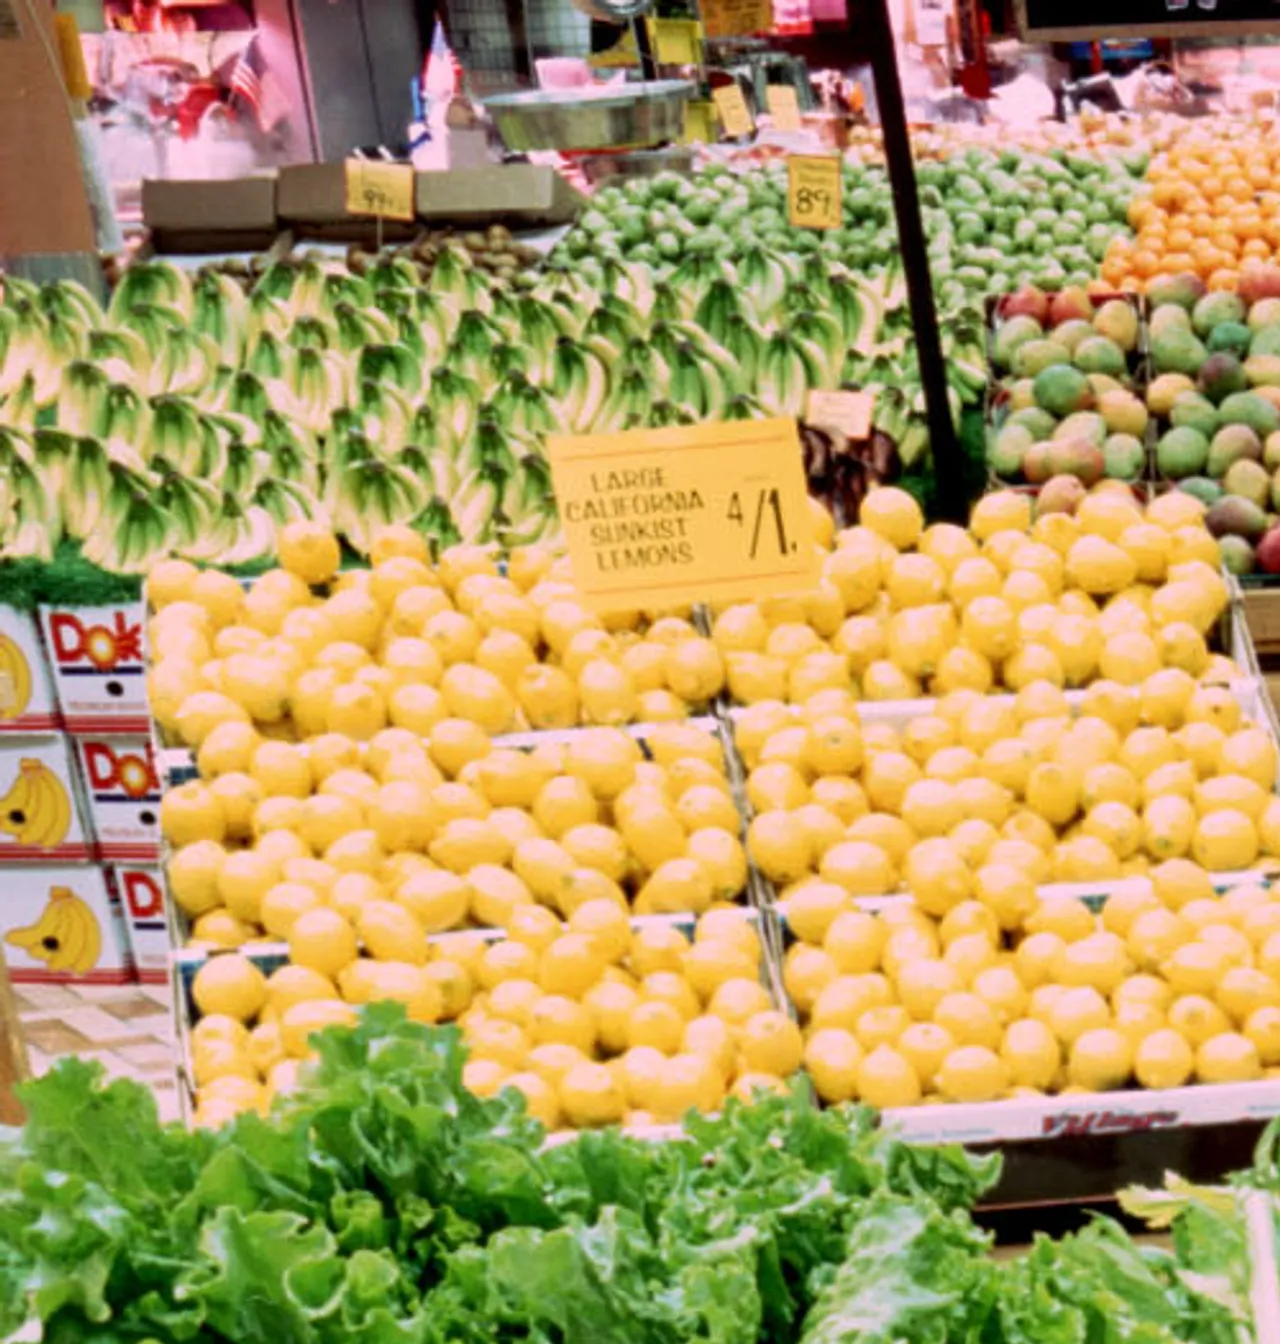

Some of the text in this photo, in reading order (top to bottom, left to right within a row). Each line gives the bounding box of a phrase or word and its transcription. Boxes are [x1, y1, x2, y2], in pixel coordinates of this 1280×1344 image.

[590, 467, 666, 494] LARGE
[565, 487, 705, 523] CALIFORNIA
[589, 516, 689, 546] SUNKIST
[596, 541, 695, 573] LEMONS
